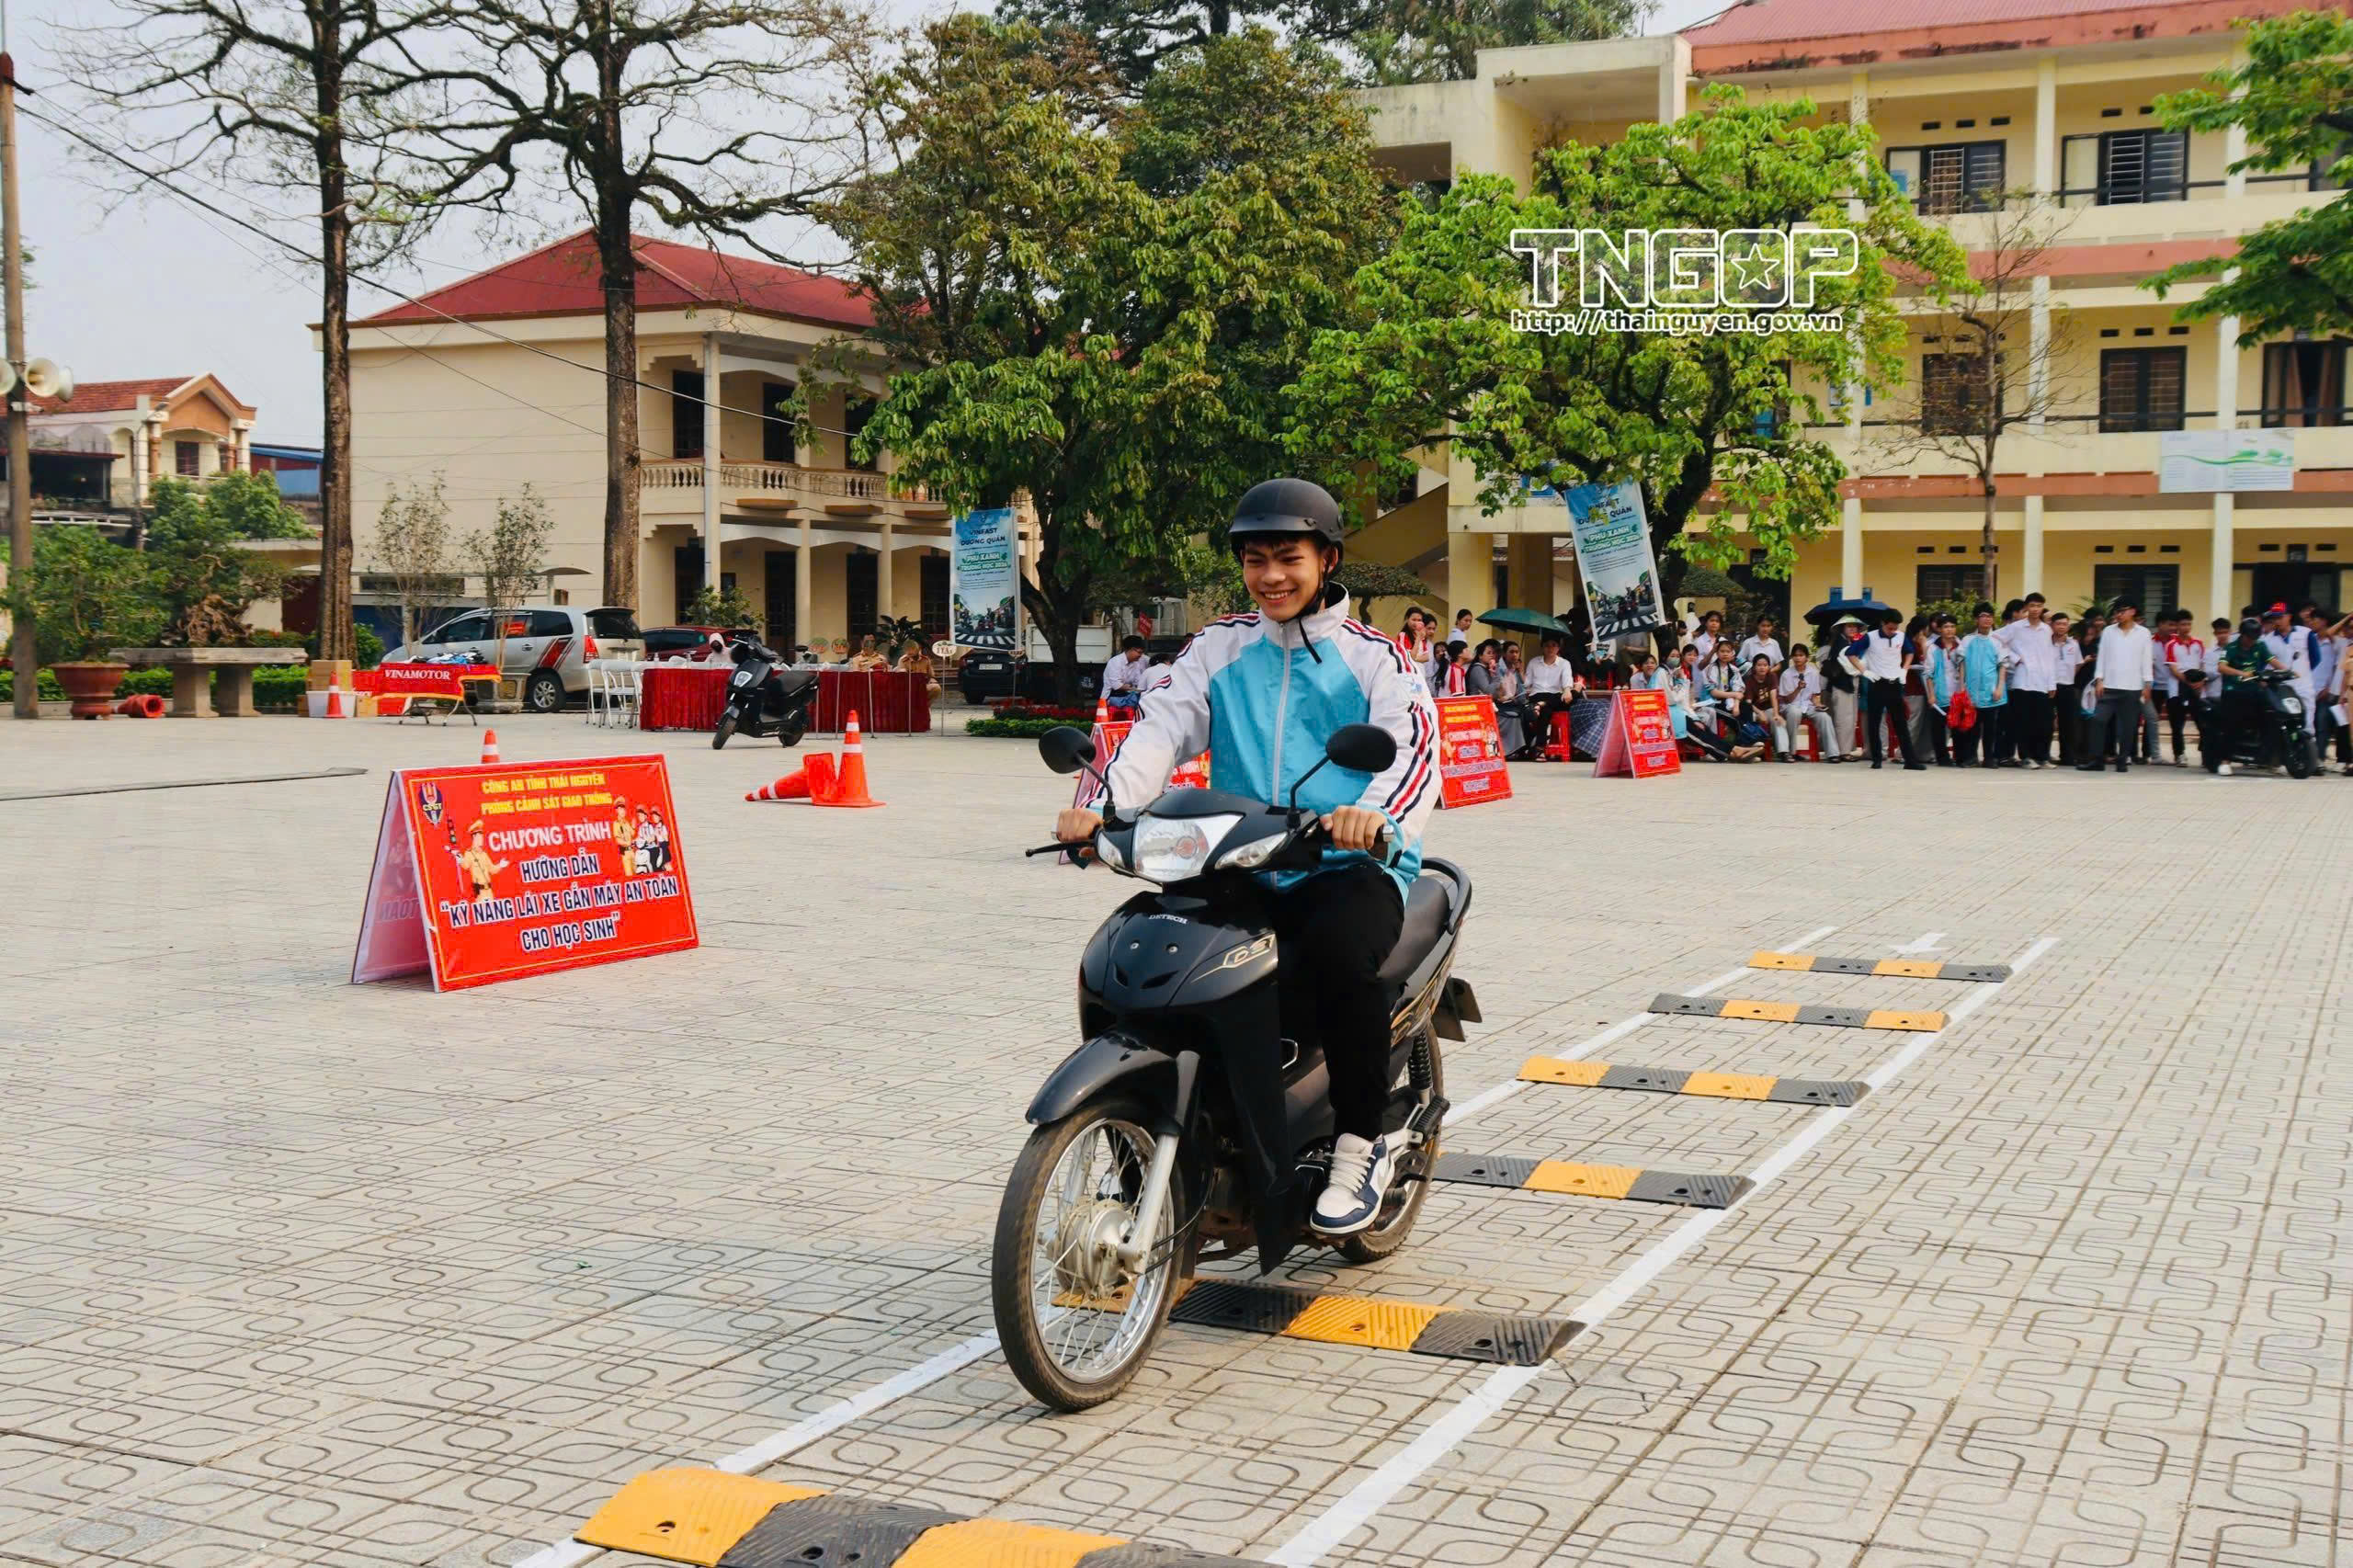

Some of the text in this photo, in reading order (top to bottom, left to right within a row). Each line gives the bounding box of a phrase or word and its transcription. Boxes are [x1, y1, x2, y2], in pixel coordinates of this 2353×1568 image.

[384, 669, 451, 680] VINAMOTOR
[488, 817, 612, 852] CHƯƠNG TRÌNH
[520, 847, 599, 882] HƯỚNG DẪN
[472, 897, 514, 924] NĂNG
[517, 892, 540, 917] LÁI
[541, 892, 561, 914] XE
[563, 882, 592, 910] GẮN
[593, 880, 622, 905] MÁY
[625, 881, 643, 902] AN
[644, 874, 678, 898] TOÀN
[1149, 914, 1188, 925] DETECH
[521, 927, 551, 950] CHO
[553, 923, 582, 949] HỌC
